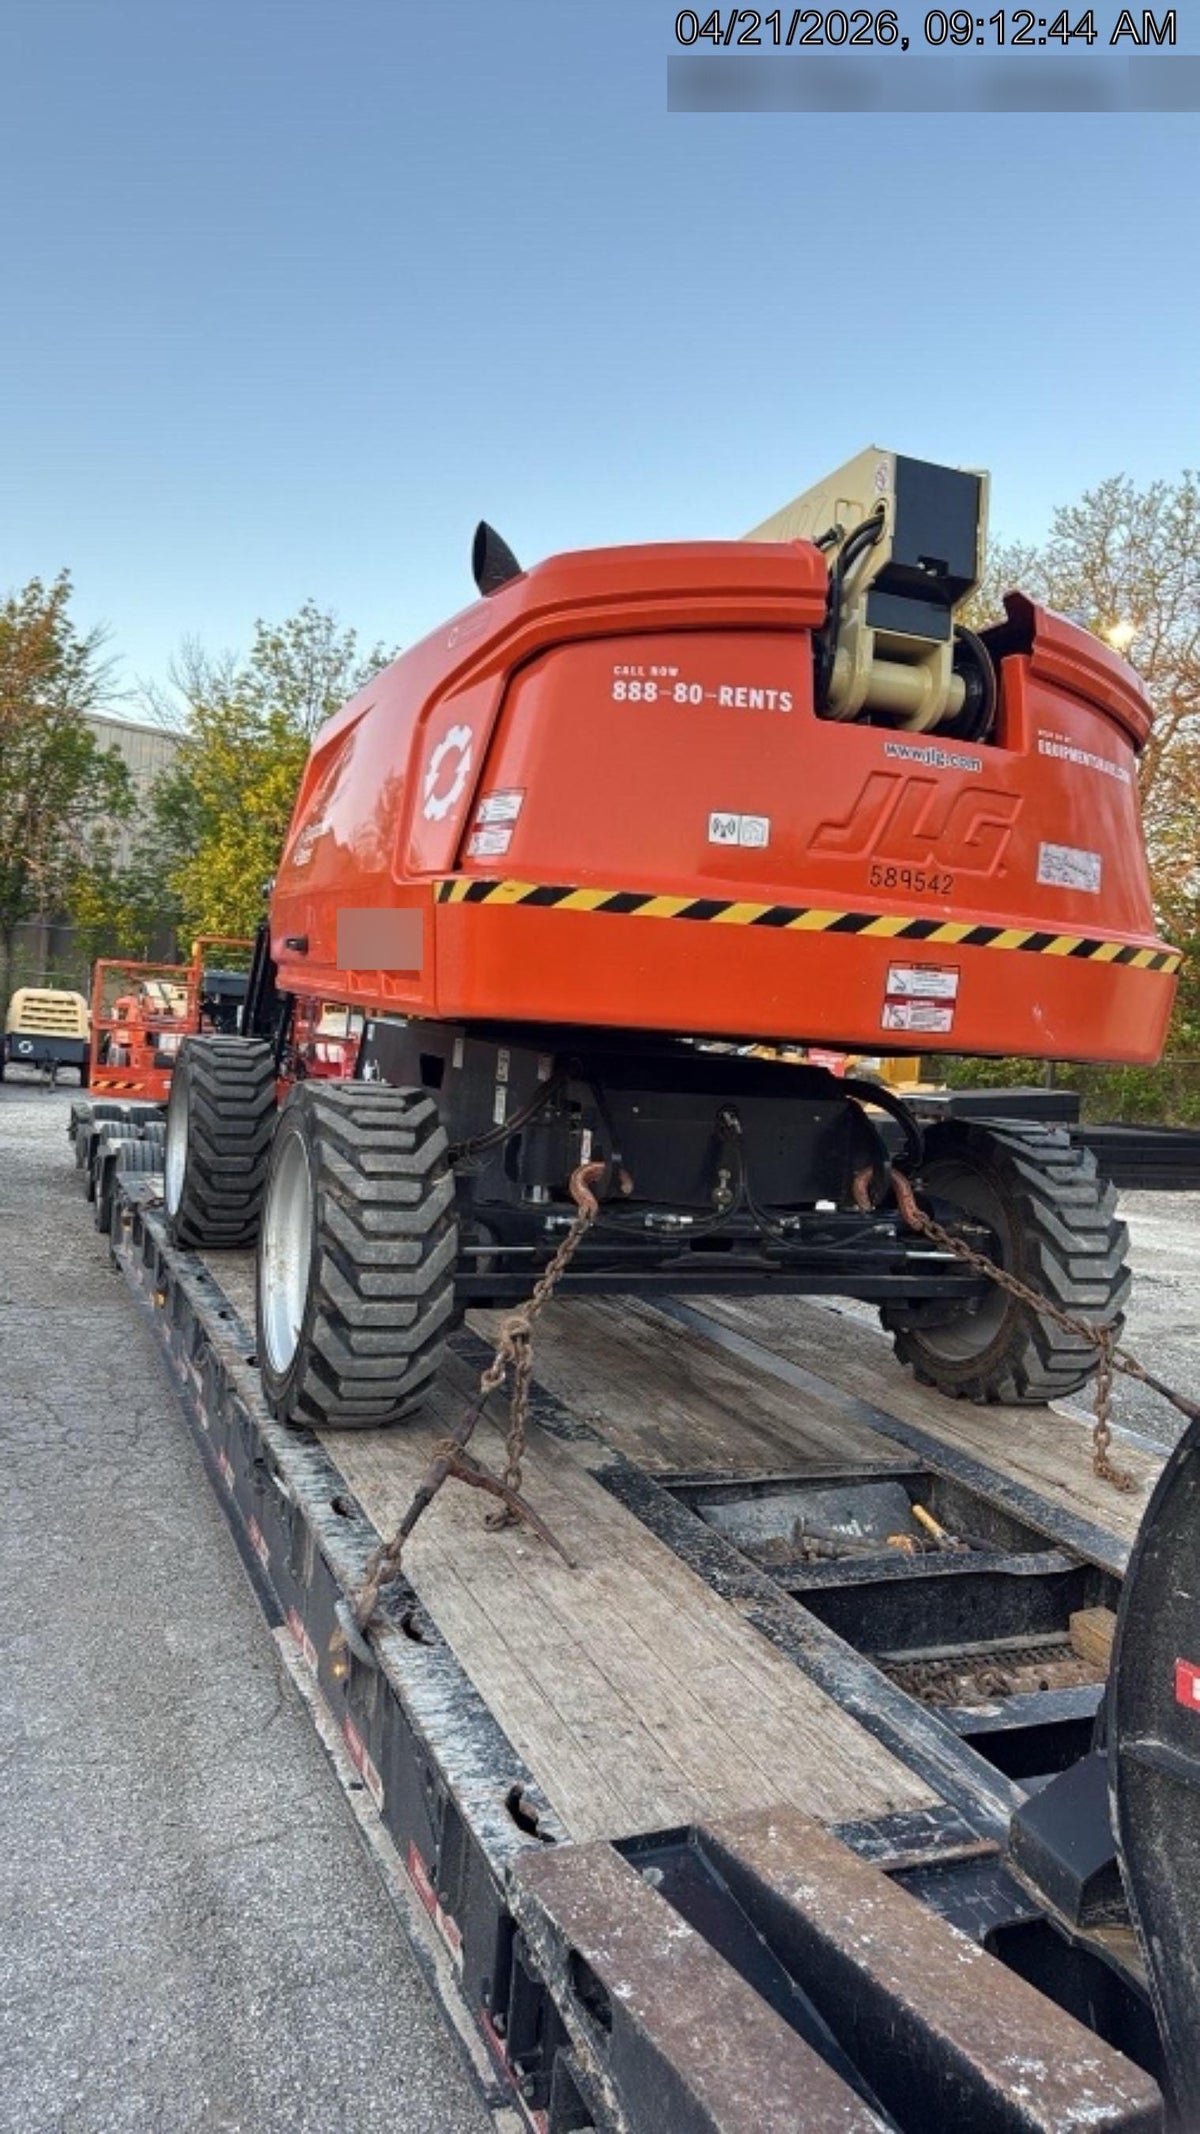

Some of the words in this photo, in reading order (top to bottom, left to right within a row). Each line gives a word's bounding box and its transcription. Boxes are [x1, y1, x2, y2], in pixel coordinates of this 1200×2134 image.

[613, 665, 646, 677] CALL
[651, 666, 679, 677] NOW
[612, 680, 794, 712] 888-80-RENTS
[884, 742, 983, 773] www.jlg.com
[805, 770, 1022, 877] JLG
[869, 865, 954, 895] 589542
